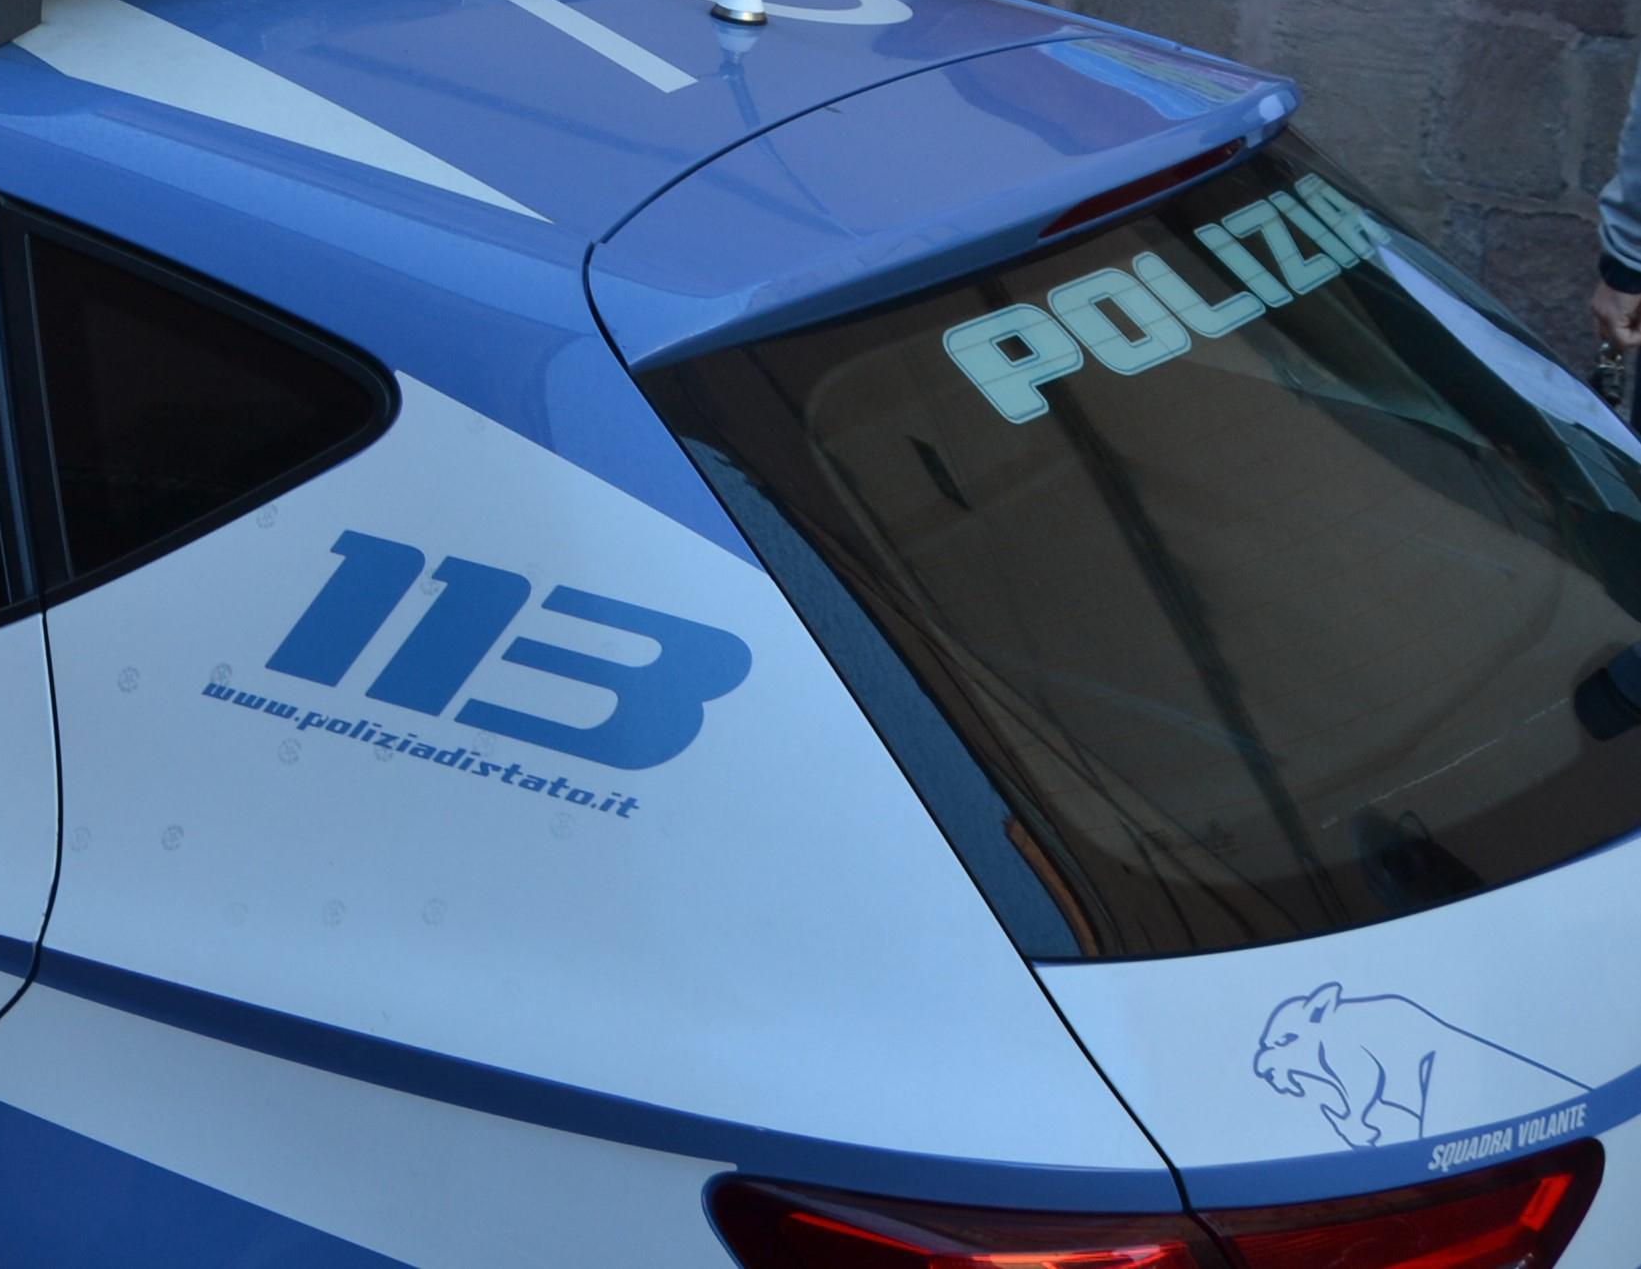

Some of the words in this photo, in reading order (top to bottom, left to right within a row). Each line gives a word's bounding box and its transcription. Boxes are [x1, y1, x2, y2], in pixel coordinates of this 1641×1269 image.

[942, 172, 1392, 425] POLIZIA
[265, 529, 753, 771] 113
[201, 682, 640, 819] www.poliziadistato.it
[1427, 1127, 1513, 1172] SQUADRA
[1518, 1103, 1588, 1148] VOLANTE
